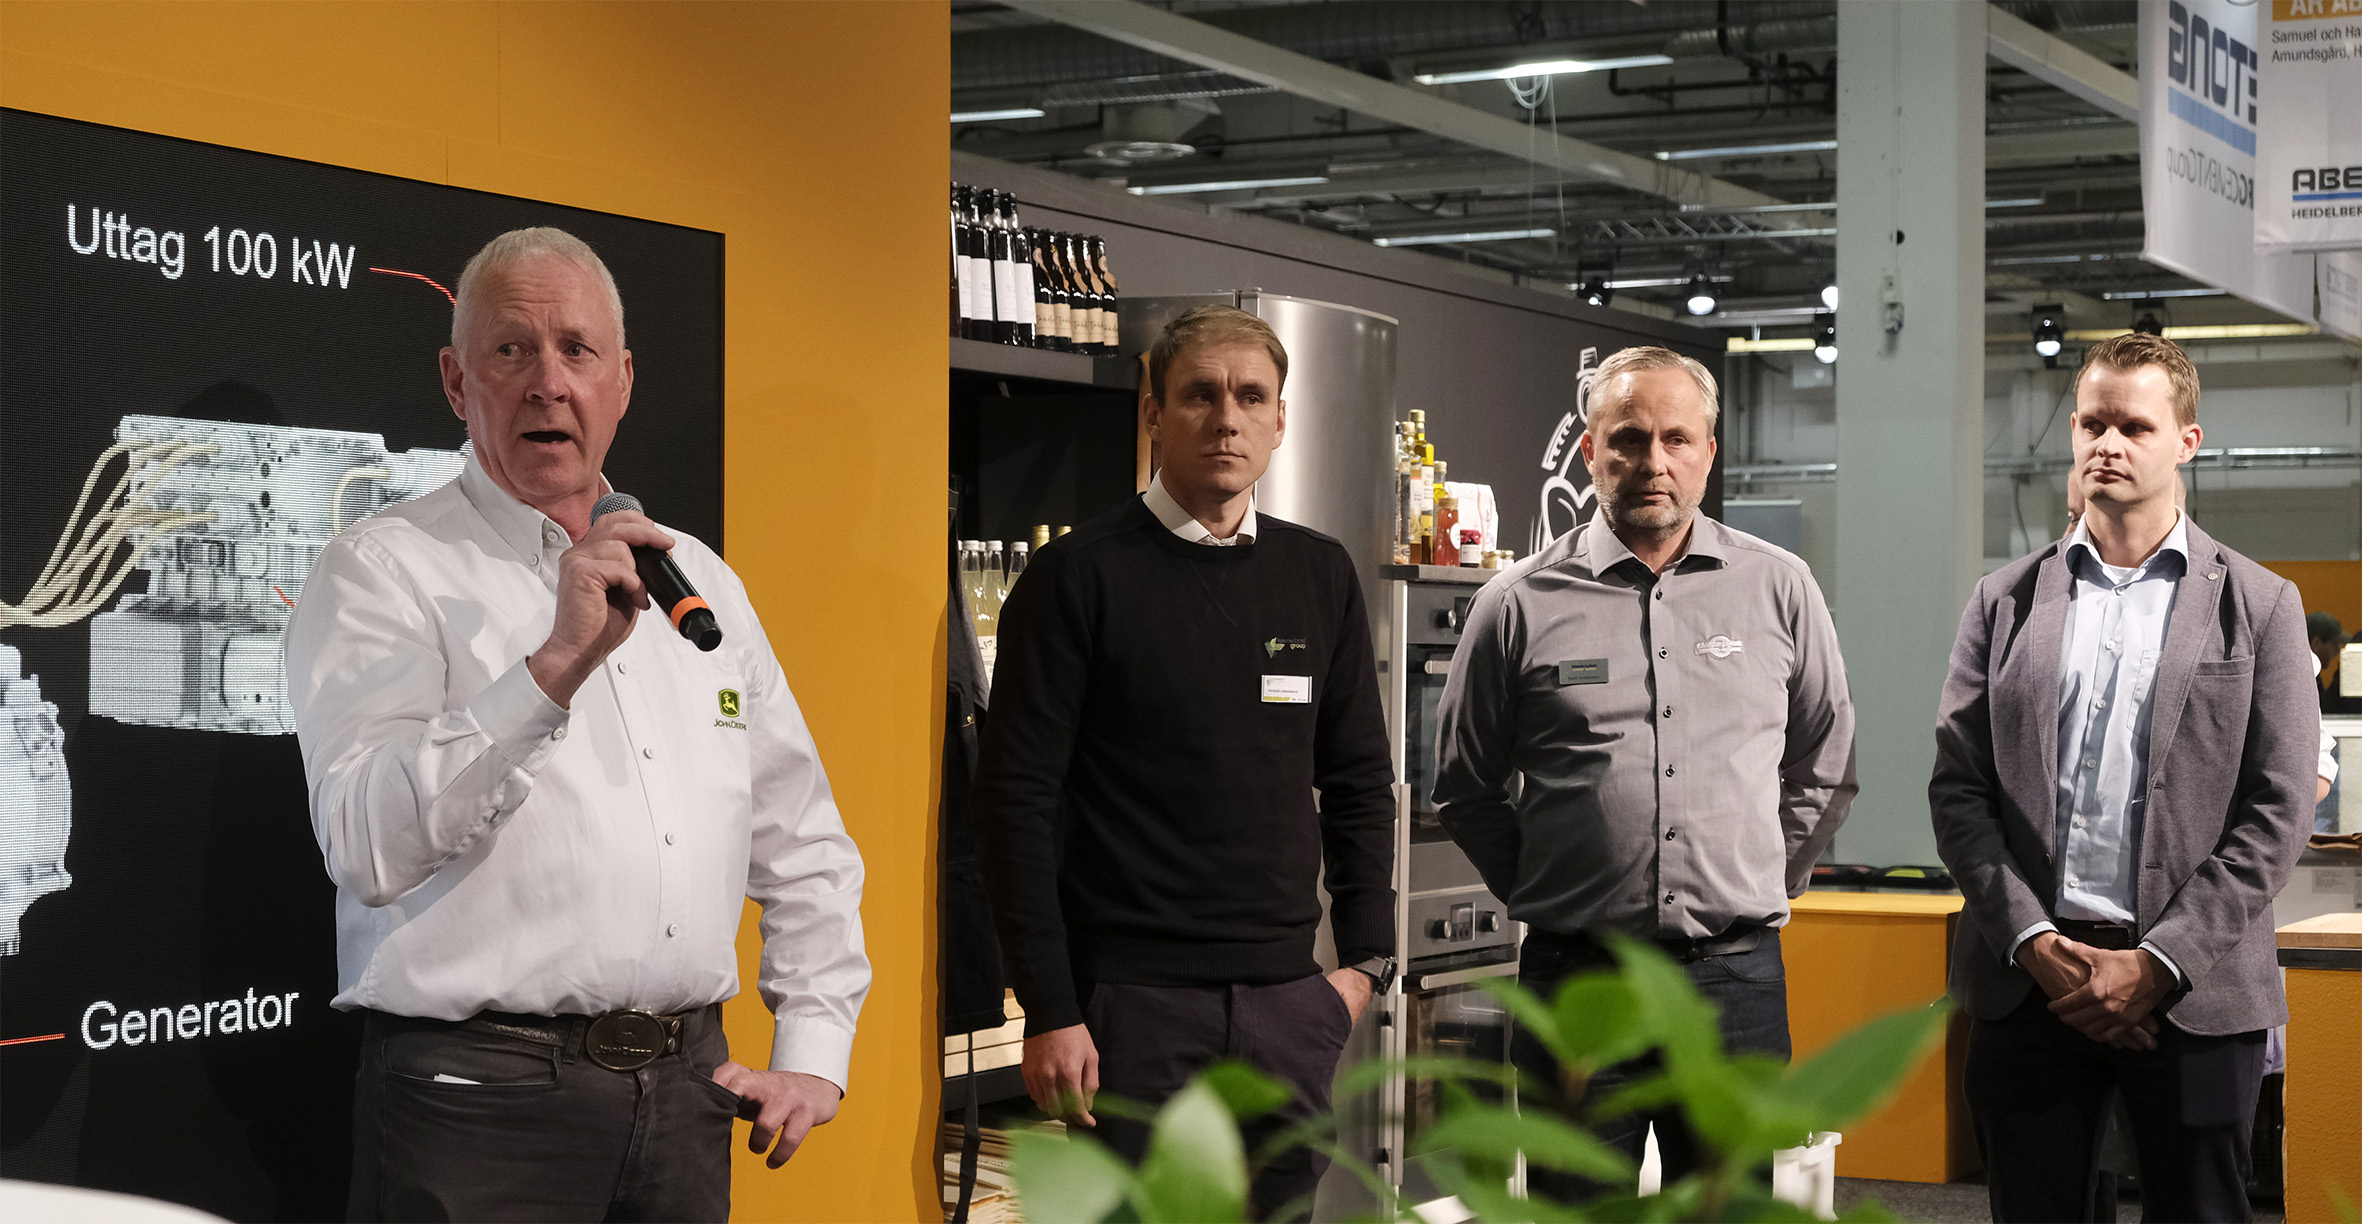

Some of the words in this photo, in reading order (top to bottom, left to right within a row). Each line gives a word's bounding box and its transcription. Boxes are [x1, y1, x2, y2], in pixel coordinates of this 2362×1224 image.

[2272, 27, 2317, 44] Samuel
[2320, 27, 2342, 41] och
[2292, 167, 2362, 192] ABE
[67, 203, 186, 279] Uttag
[203, 226, 278, 279] 100
[292, 236, 356, 290] kW
[81, 987, 300, 1050] Generator
